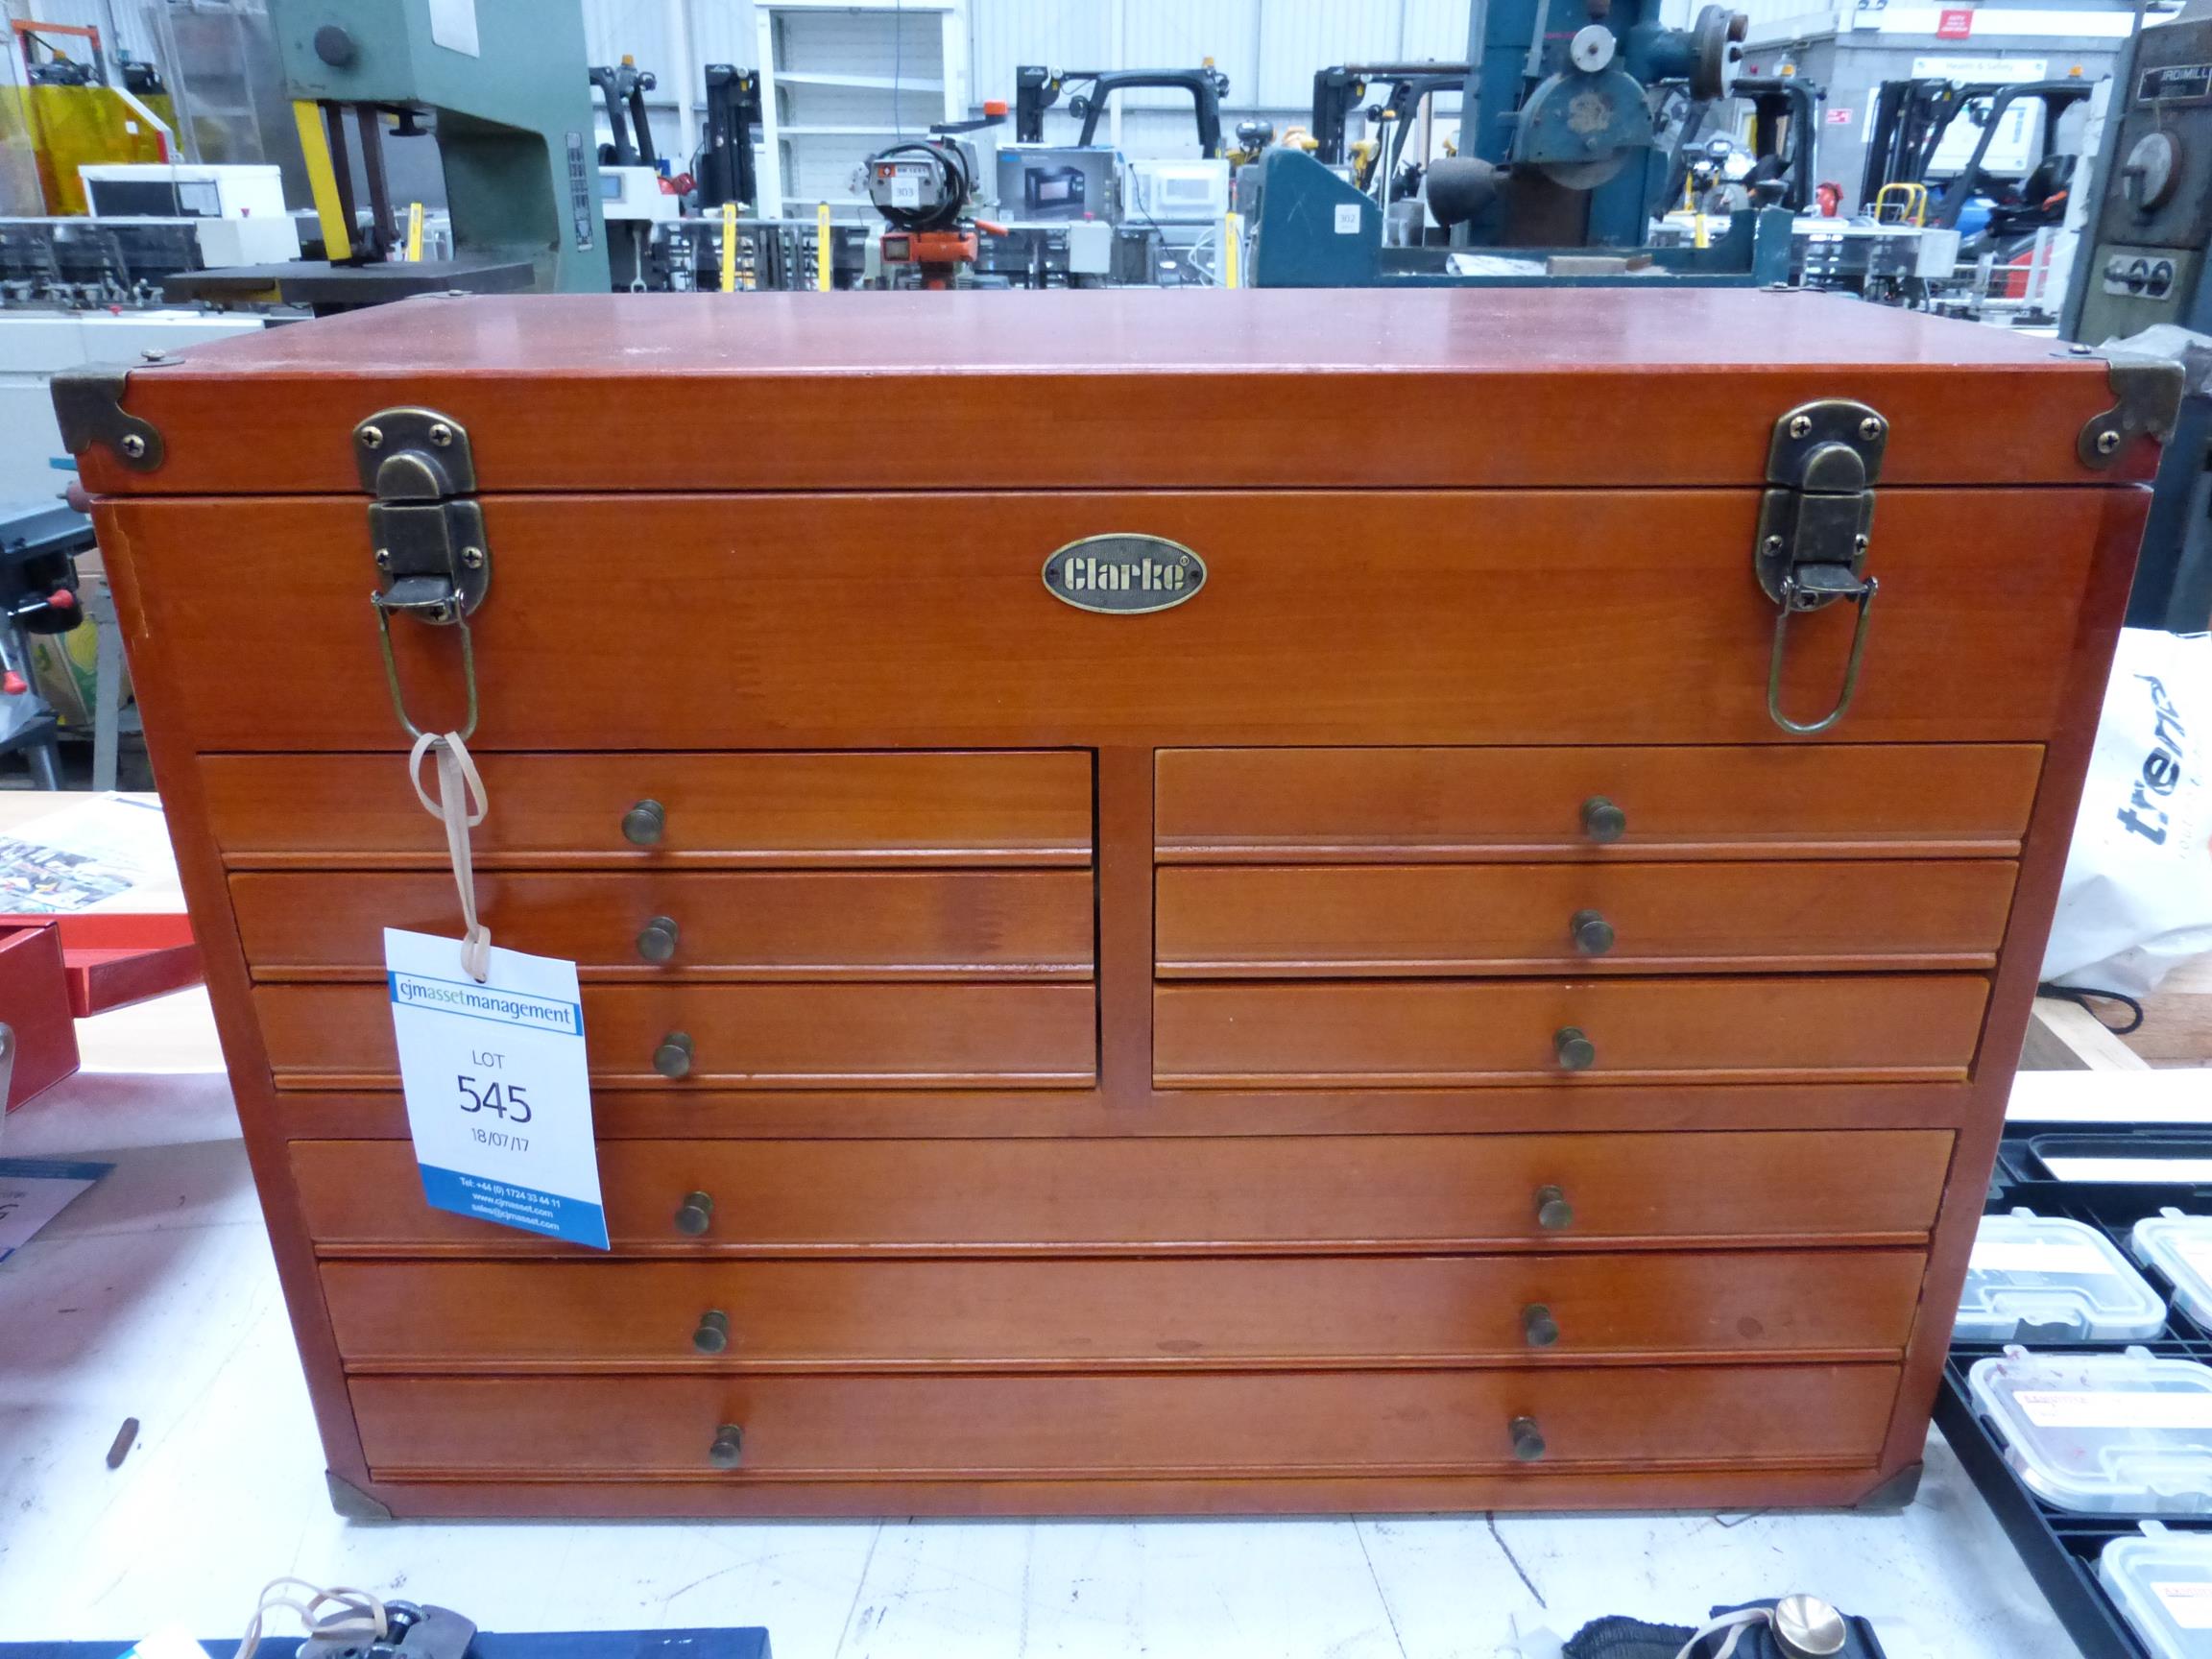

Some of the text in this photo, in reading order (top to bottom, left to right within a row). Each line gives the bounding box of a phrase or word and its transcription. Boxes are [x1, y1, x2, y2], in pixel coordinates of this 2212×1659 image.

[896, 187, 915, 198] 303
[400, 979, 571, 1024] cjmassetmanagement
[472, 1050, 505, 1069] LOT
[457, 1074, 532, 1123] 545
[470, 1127, 530, 1152] 18/07/17
[459, 1176, 476, 1188] Tel:
[476, 1182, 492, 1192] +44
[493, 1185, 504, 1196] (0)
[506, 1189, 526, 1200] 1724
[539, 1195, 550, 1206] 44
[551, 1199, 561, 1209] 11
[471, 1193, 554, 1218] www.cjmasset.com
